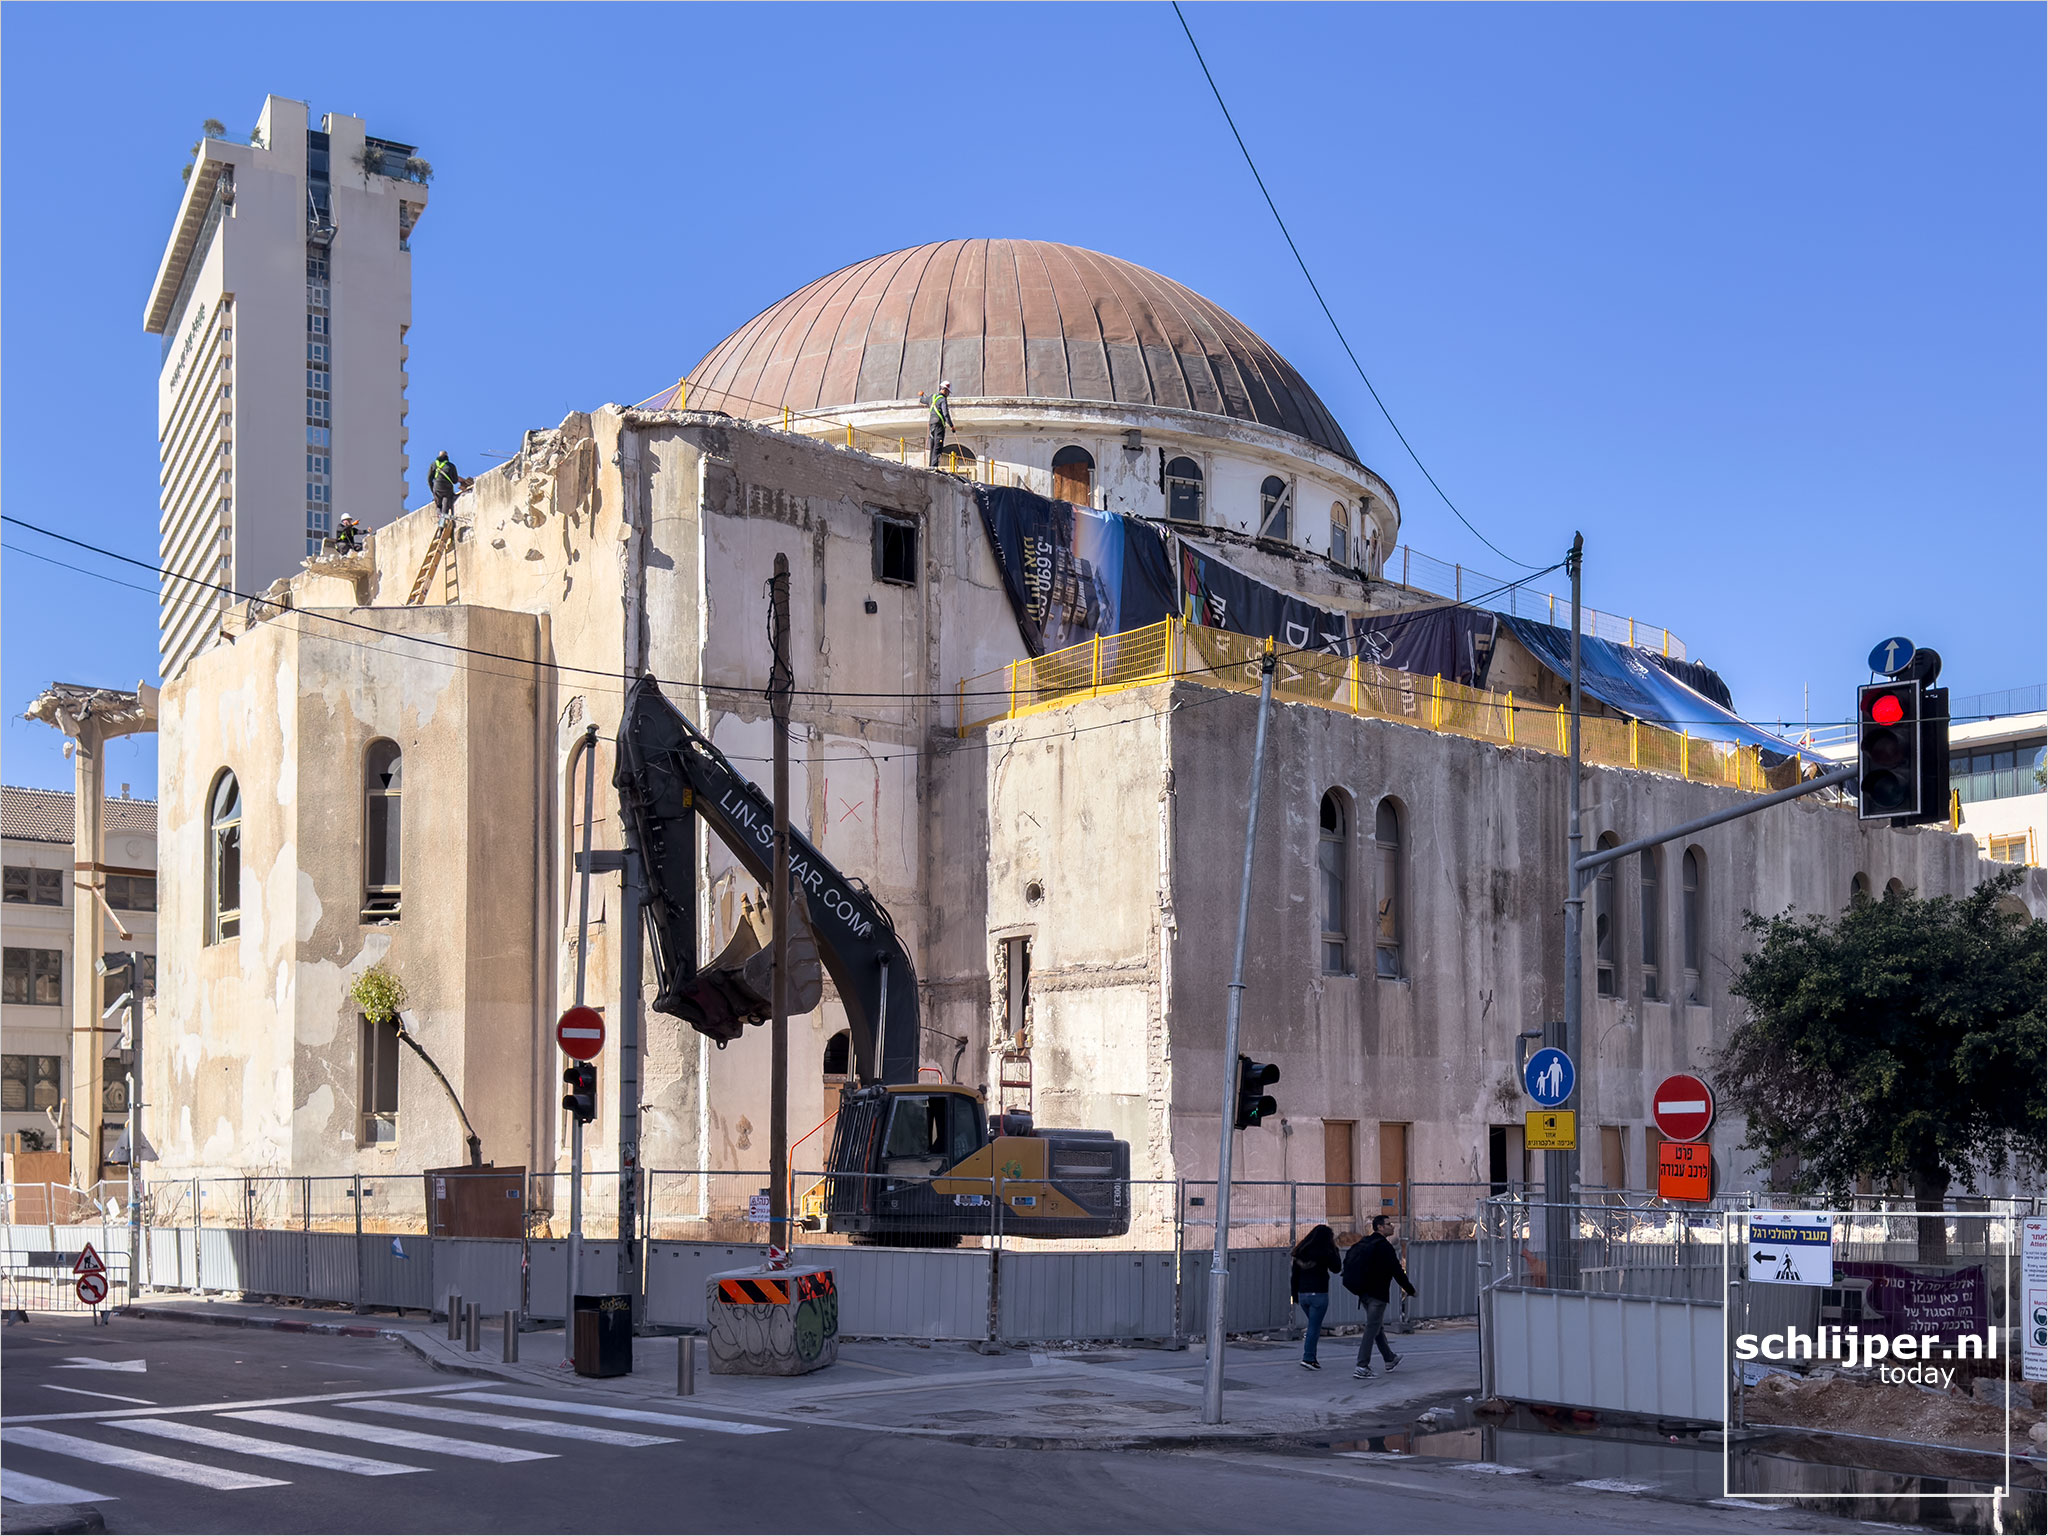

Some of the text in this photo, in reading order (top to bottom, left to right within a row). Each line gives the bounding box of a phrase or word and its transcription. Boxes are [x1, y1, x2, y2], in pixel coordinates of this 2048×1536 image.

[719, 788, 874, 938] LIN-SHAR.COM
[1675, 1146, 1693, 1161] פרט
[1659, 1163, 1708, 1179] לרכב עבודה
[1751, 1225, 1828, 1242] מעבר להולכי רגל
[1909, 1278, 1925, 1293] לך
[1939, 1293, 1959, 1306] כאן
[1962, 1292, 1974, 1302] גם
[1903, 1304, 1974, 1318] הקו הסגול של
[1907, 1319, 1975, 1333] הרכבת הקלה.
